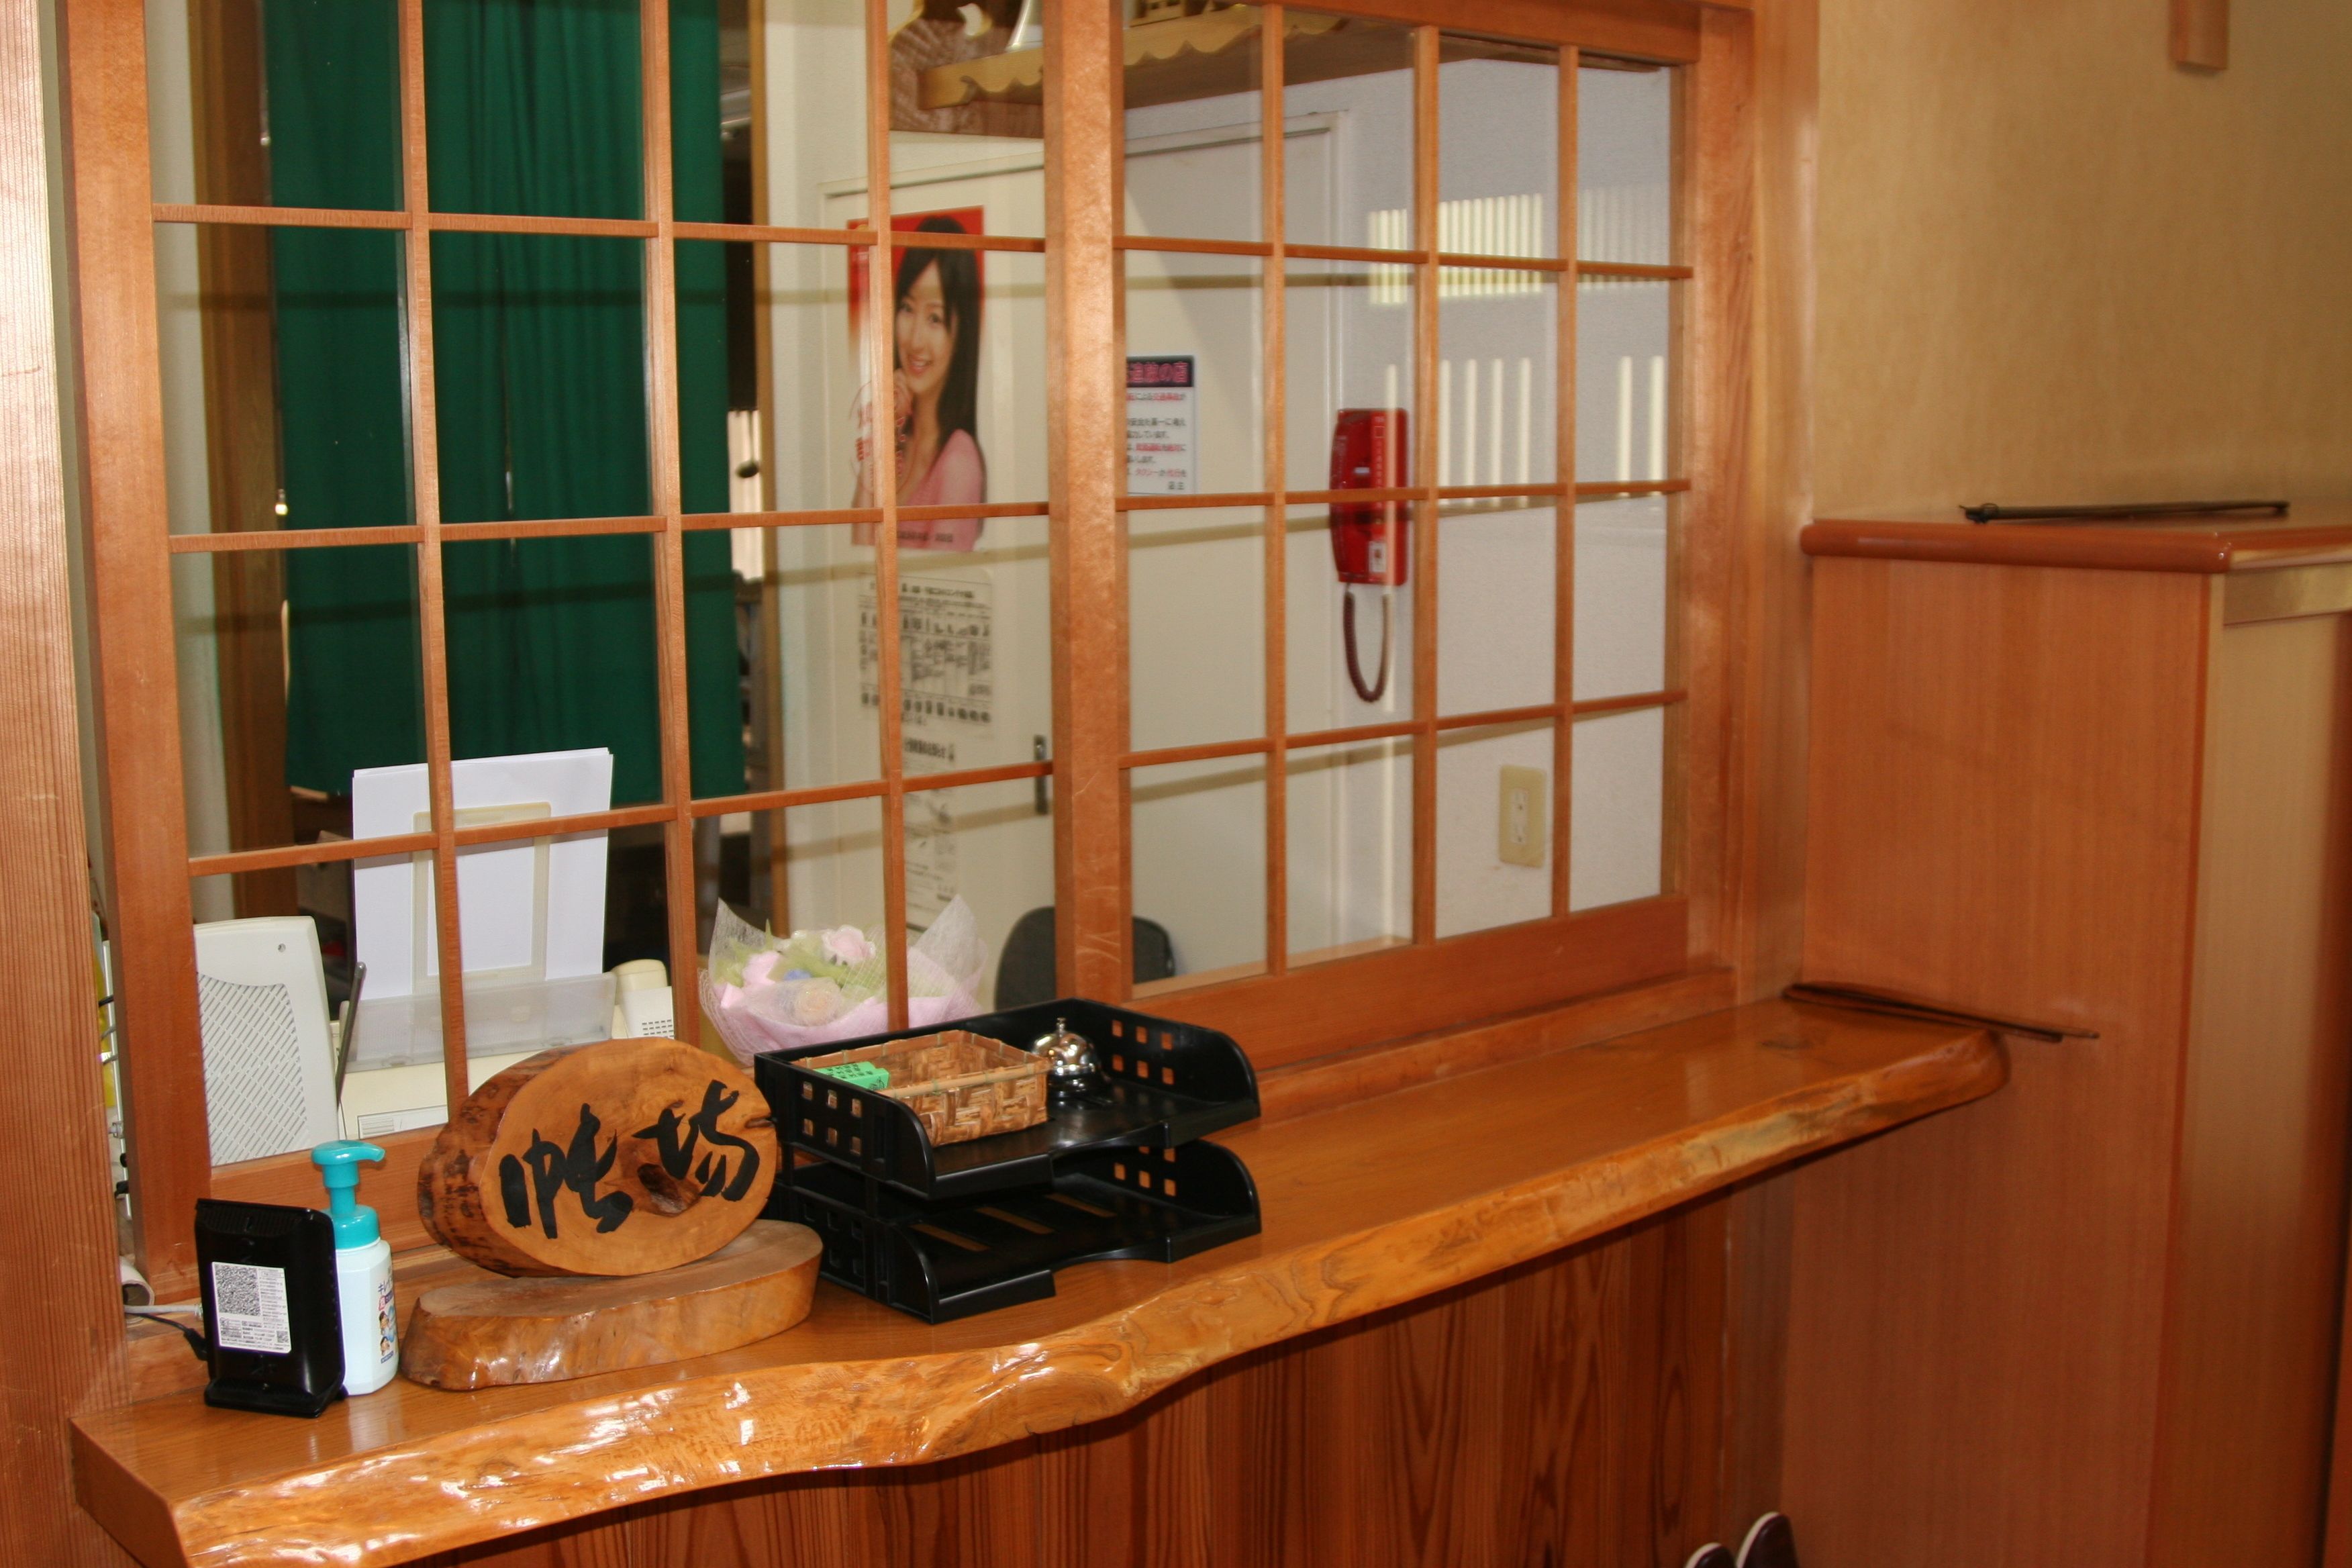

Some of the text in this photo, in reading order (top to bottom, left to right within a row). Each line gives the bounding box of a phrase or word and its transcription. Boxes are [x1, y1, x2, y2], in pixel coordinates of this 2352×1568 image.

[1127, 361, 1187, 383] 追放の店
[378, 1277, 393, 1295] キレイ
